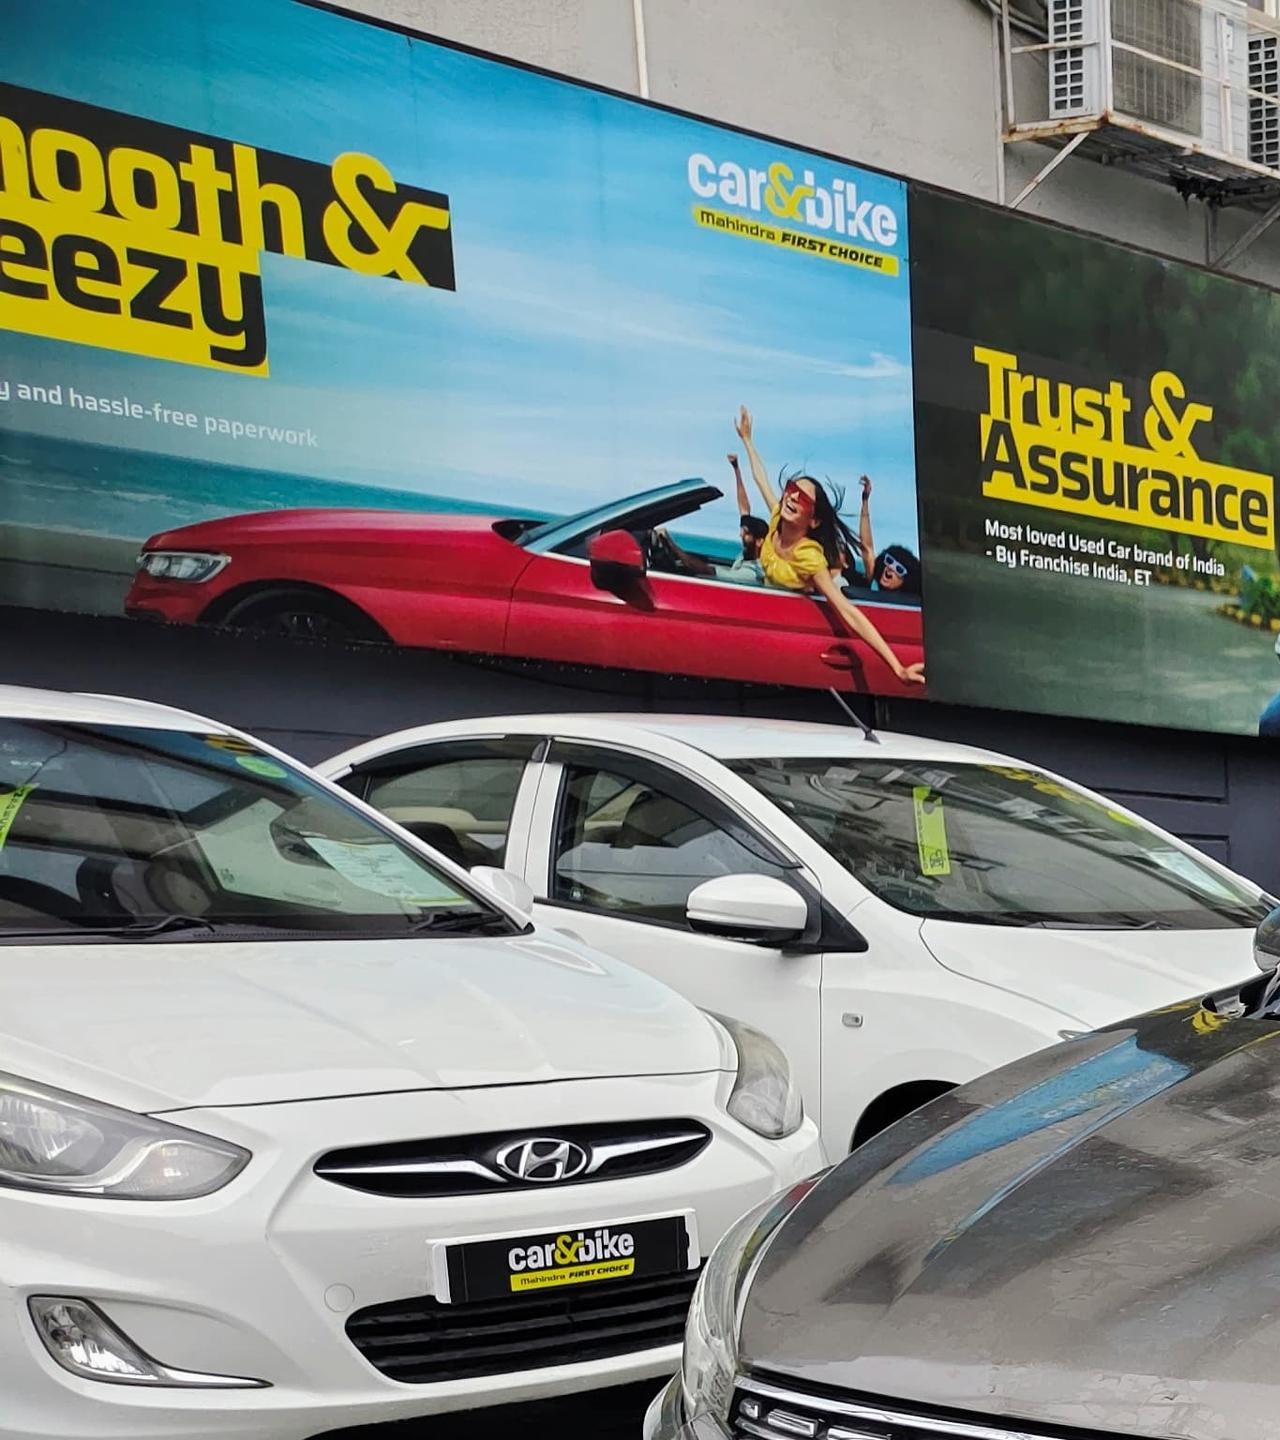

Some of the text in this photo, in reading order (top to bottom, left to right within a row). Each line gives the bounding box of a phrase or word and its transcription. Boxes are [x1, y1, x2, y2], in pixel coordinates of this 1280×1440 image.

[323, 151, 450, 286] &
[688, 153, 898, 247] car&bike
[700, 210, 884, 268] Mahindra FIRST CHOICE
[17, 383, 62, 405] and
[69, 387, 198, 428] hassle-free
[204, 415, 318, 448] paperwork
[974, 345, 1213, 461] Trust &
[980, 419, 1268, 537] Assurance
[985, 519, 1225, 577] Most loved Used Car brand of India
[995, 545, 1016, 568] By
[1020, 550, 1090, 577] Franchise
[1092, 563, 1132, 586] India,
[1134, 568, 1152, 587] ET
[508, 1229, 634, 1271] car&bike
[520, 1264, 630, 1285] Mahindra FIRST CHOICE
